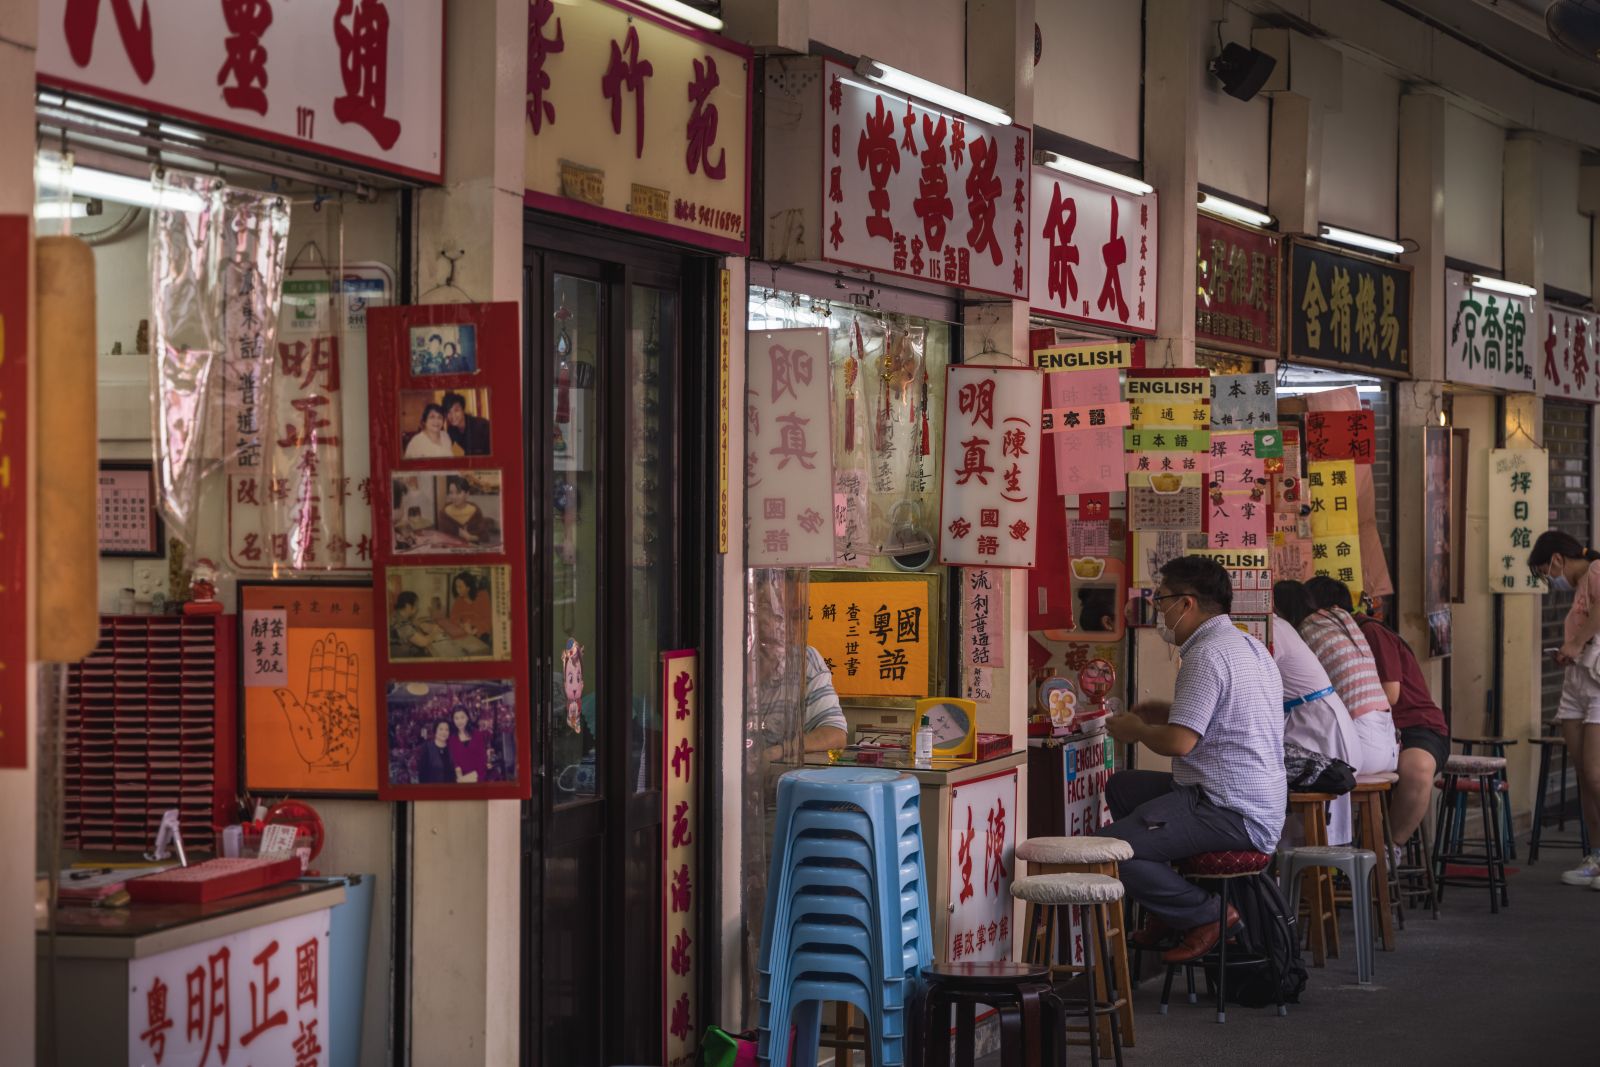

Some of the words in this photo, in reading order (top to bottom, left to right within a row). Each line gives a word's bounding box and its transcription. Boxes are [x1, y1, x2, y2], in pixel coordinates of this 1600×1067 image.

[296, 107, 315, 139] 117
[829, 73, 844, 251] 擇日風水
[699, 205, 742, 233] 94116899
[929, 258, 941, 279] 115
[1037, 350, 1123, 368] ENGLISH
[277, 336, 340, 448] 明正
[1128, 381, 1203, 394] ENGLISH
[1042, 408, 1106, 430] 日本語
[1131, 406, 1207, 421] 普通話
[955, 378, 996, 486] 明真
[1132, 433, 1188, 448] 日本語
[1137, 456, 1196, 472] 廣東話
[237, 478, 262, 562] 改名
[1509, 471, 1532, 549] 擇日館
[977, 508, 1000, 556] 國語
[1190, 554, 1264, 566] GLISH
[970, 570, 992, 664] 流利普通話
[1068, 776, 1085, 804] FACE
[186, 945, 288, 1067] 明正
